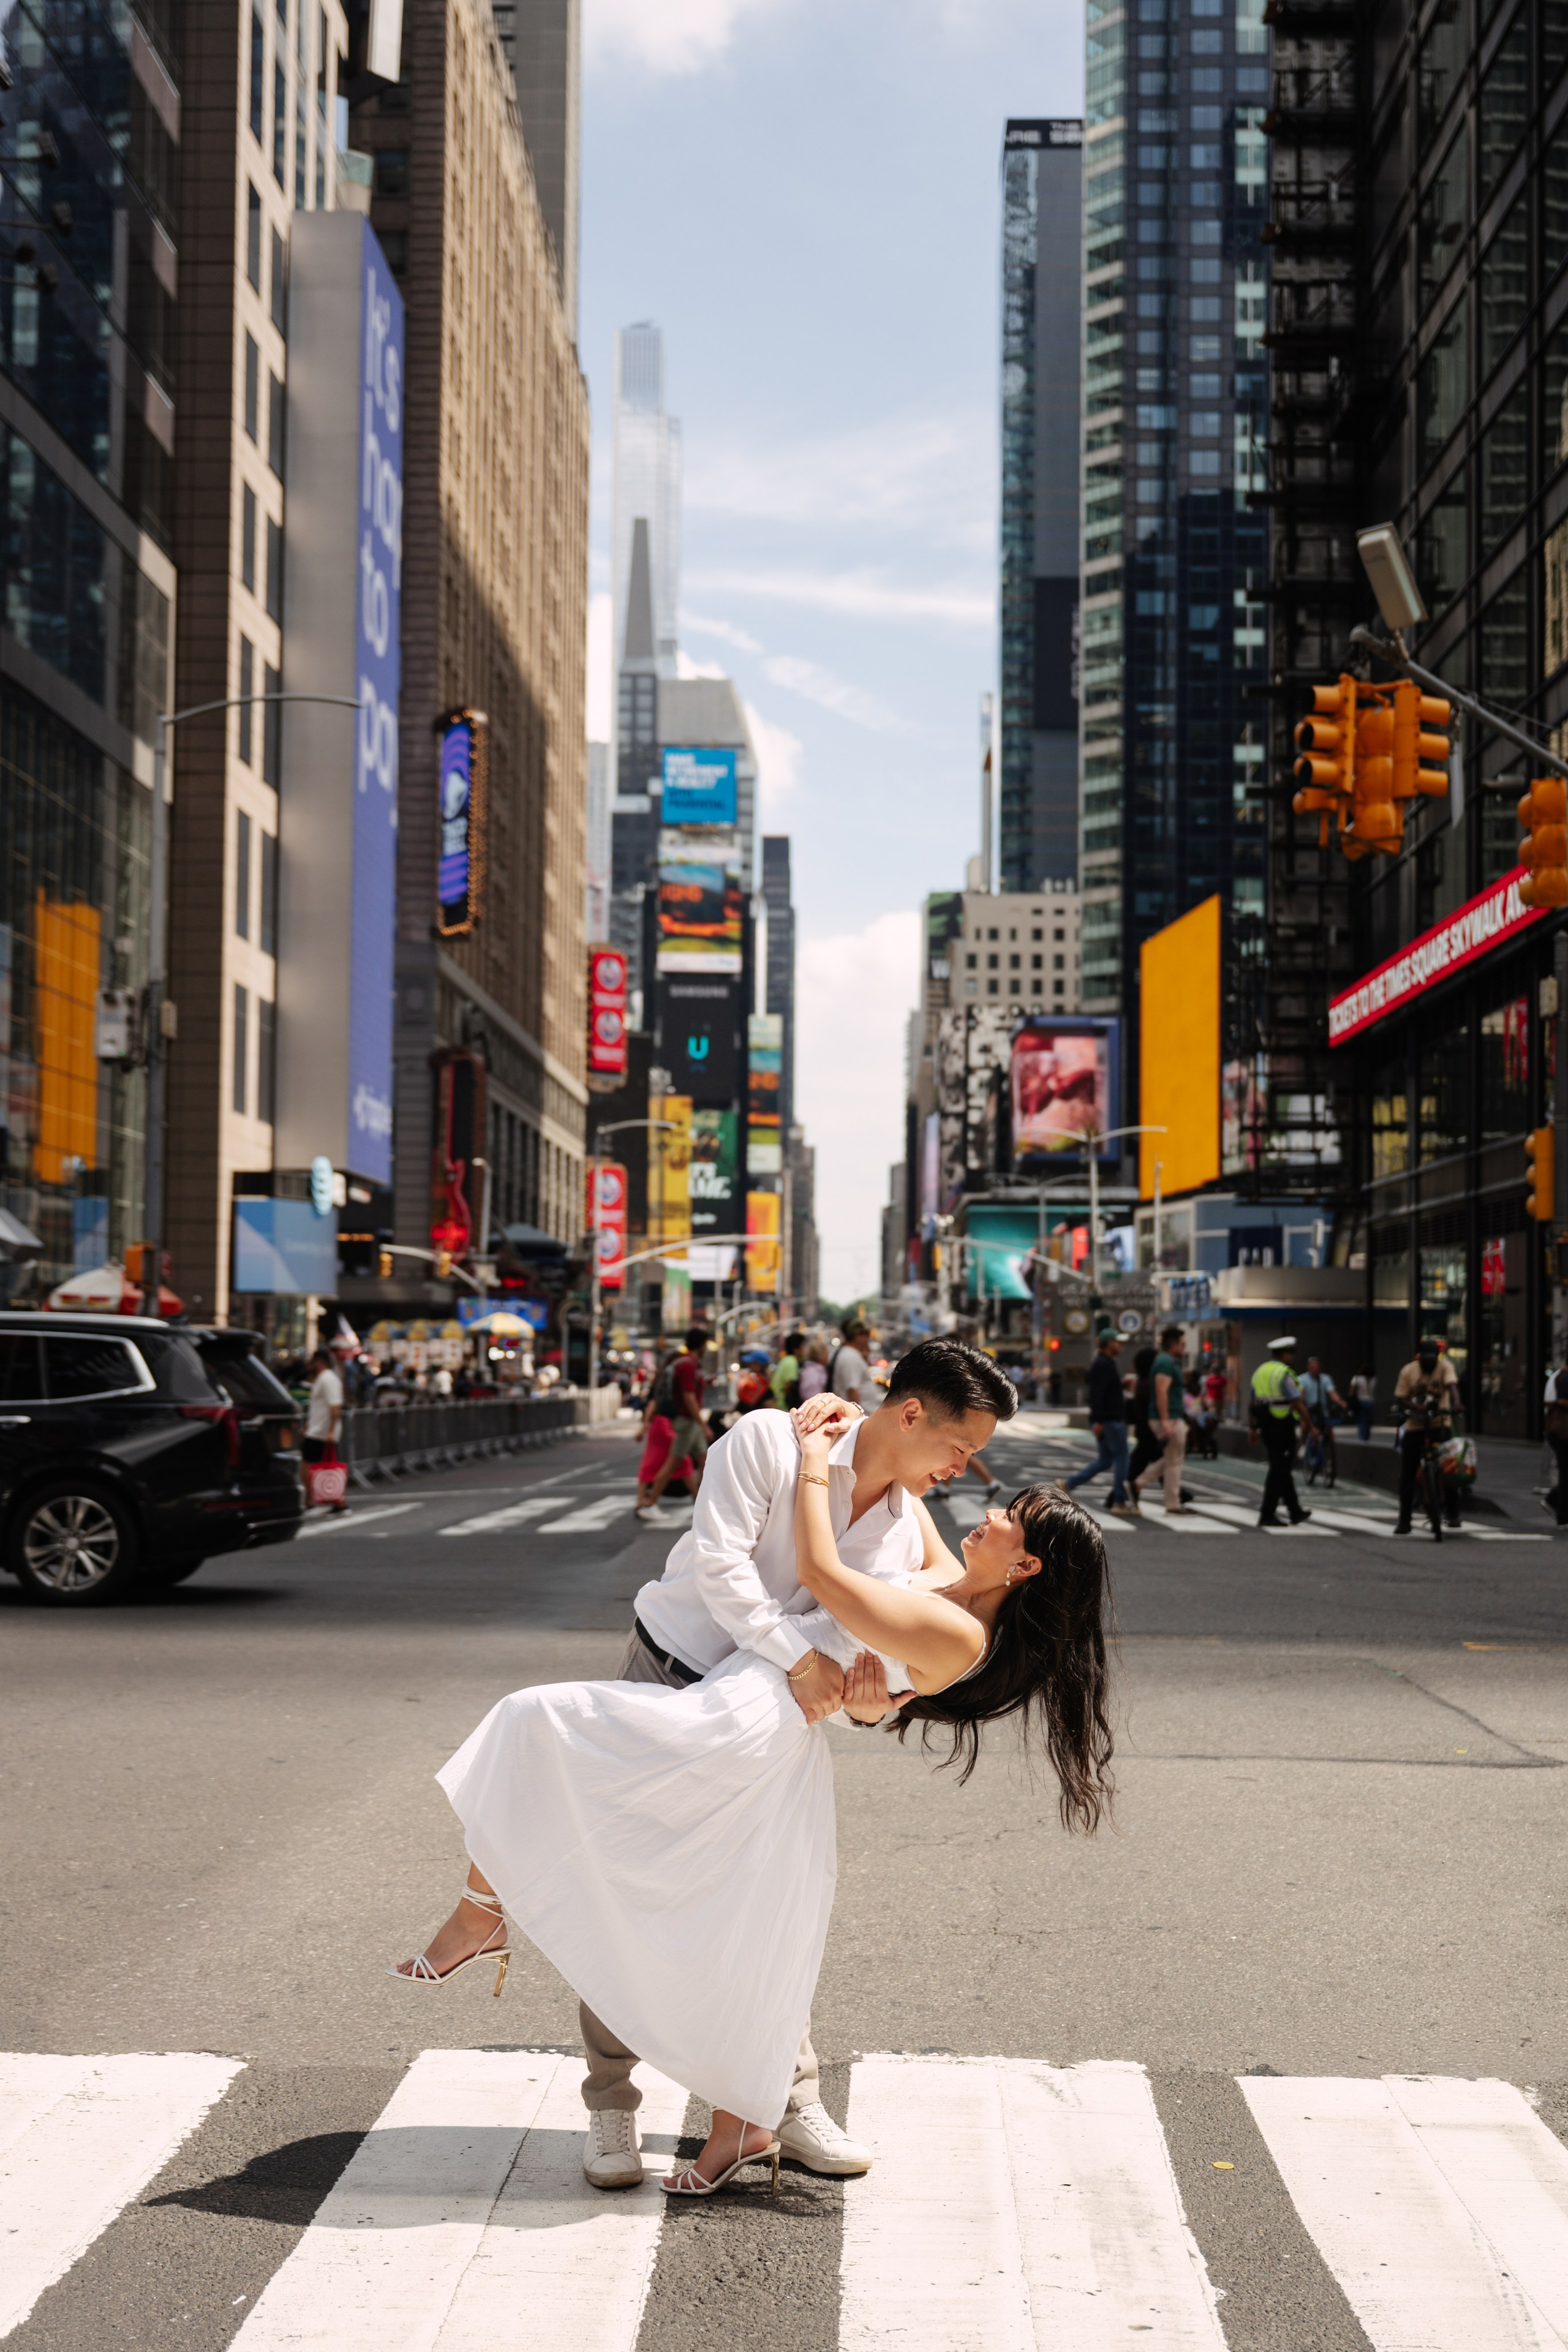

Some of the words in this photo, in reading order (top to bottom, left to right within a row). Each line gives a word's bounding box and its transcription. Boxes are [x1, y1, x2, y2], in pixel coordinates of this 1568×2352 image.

[366, 266, 401, 432] It's
[360, 529, 389, 659] to
[1329, 992, 1358, 1038] TICKETS
[1357, 984, 1370, 1020] TO
[1369, 972, 1386, 1013] THE
[1385, 955, 1411, 1003] TIMES
[1411, 927, 1450, 986] SQUARE
[1450, 888, 1506, 961] SKYWALK
